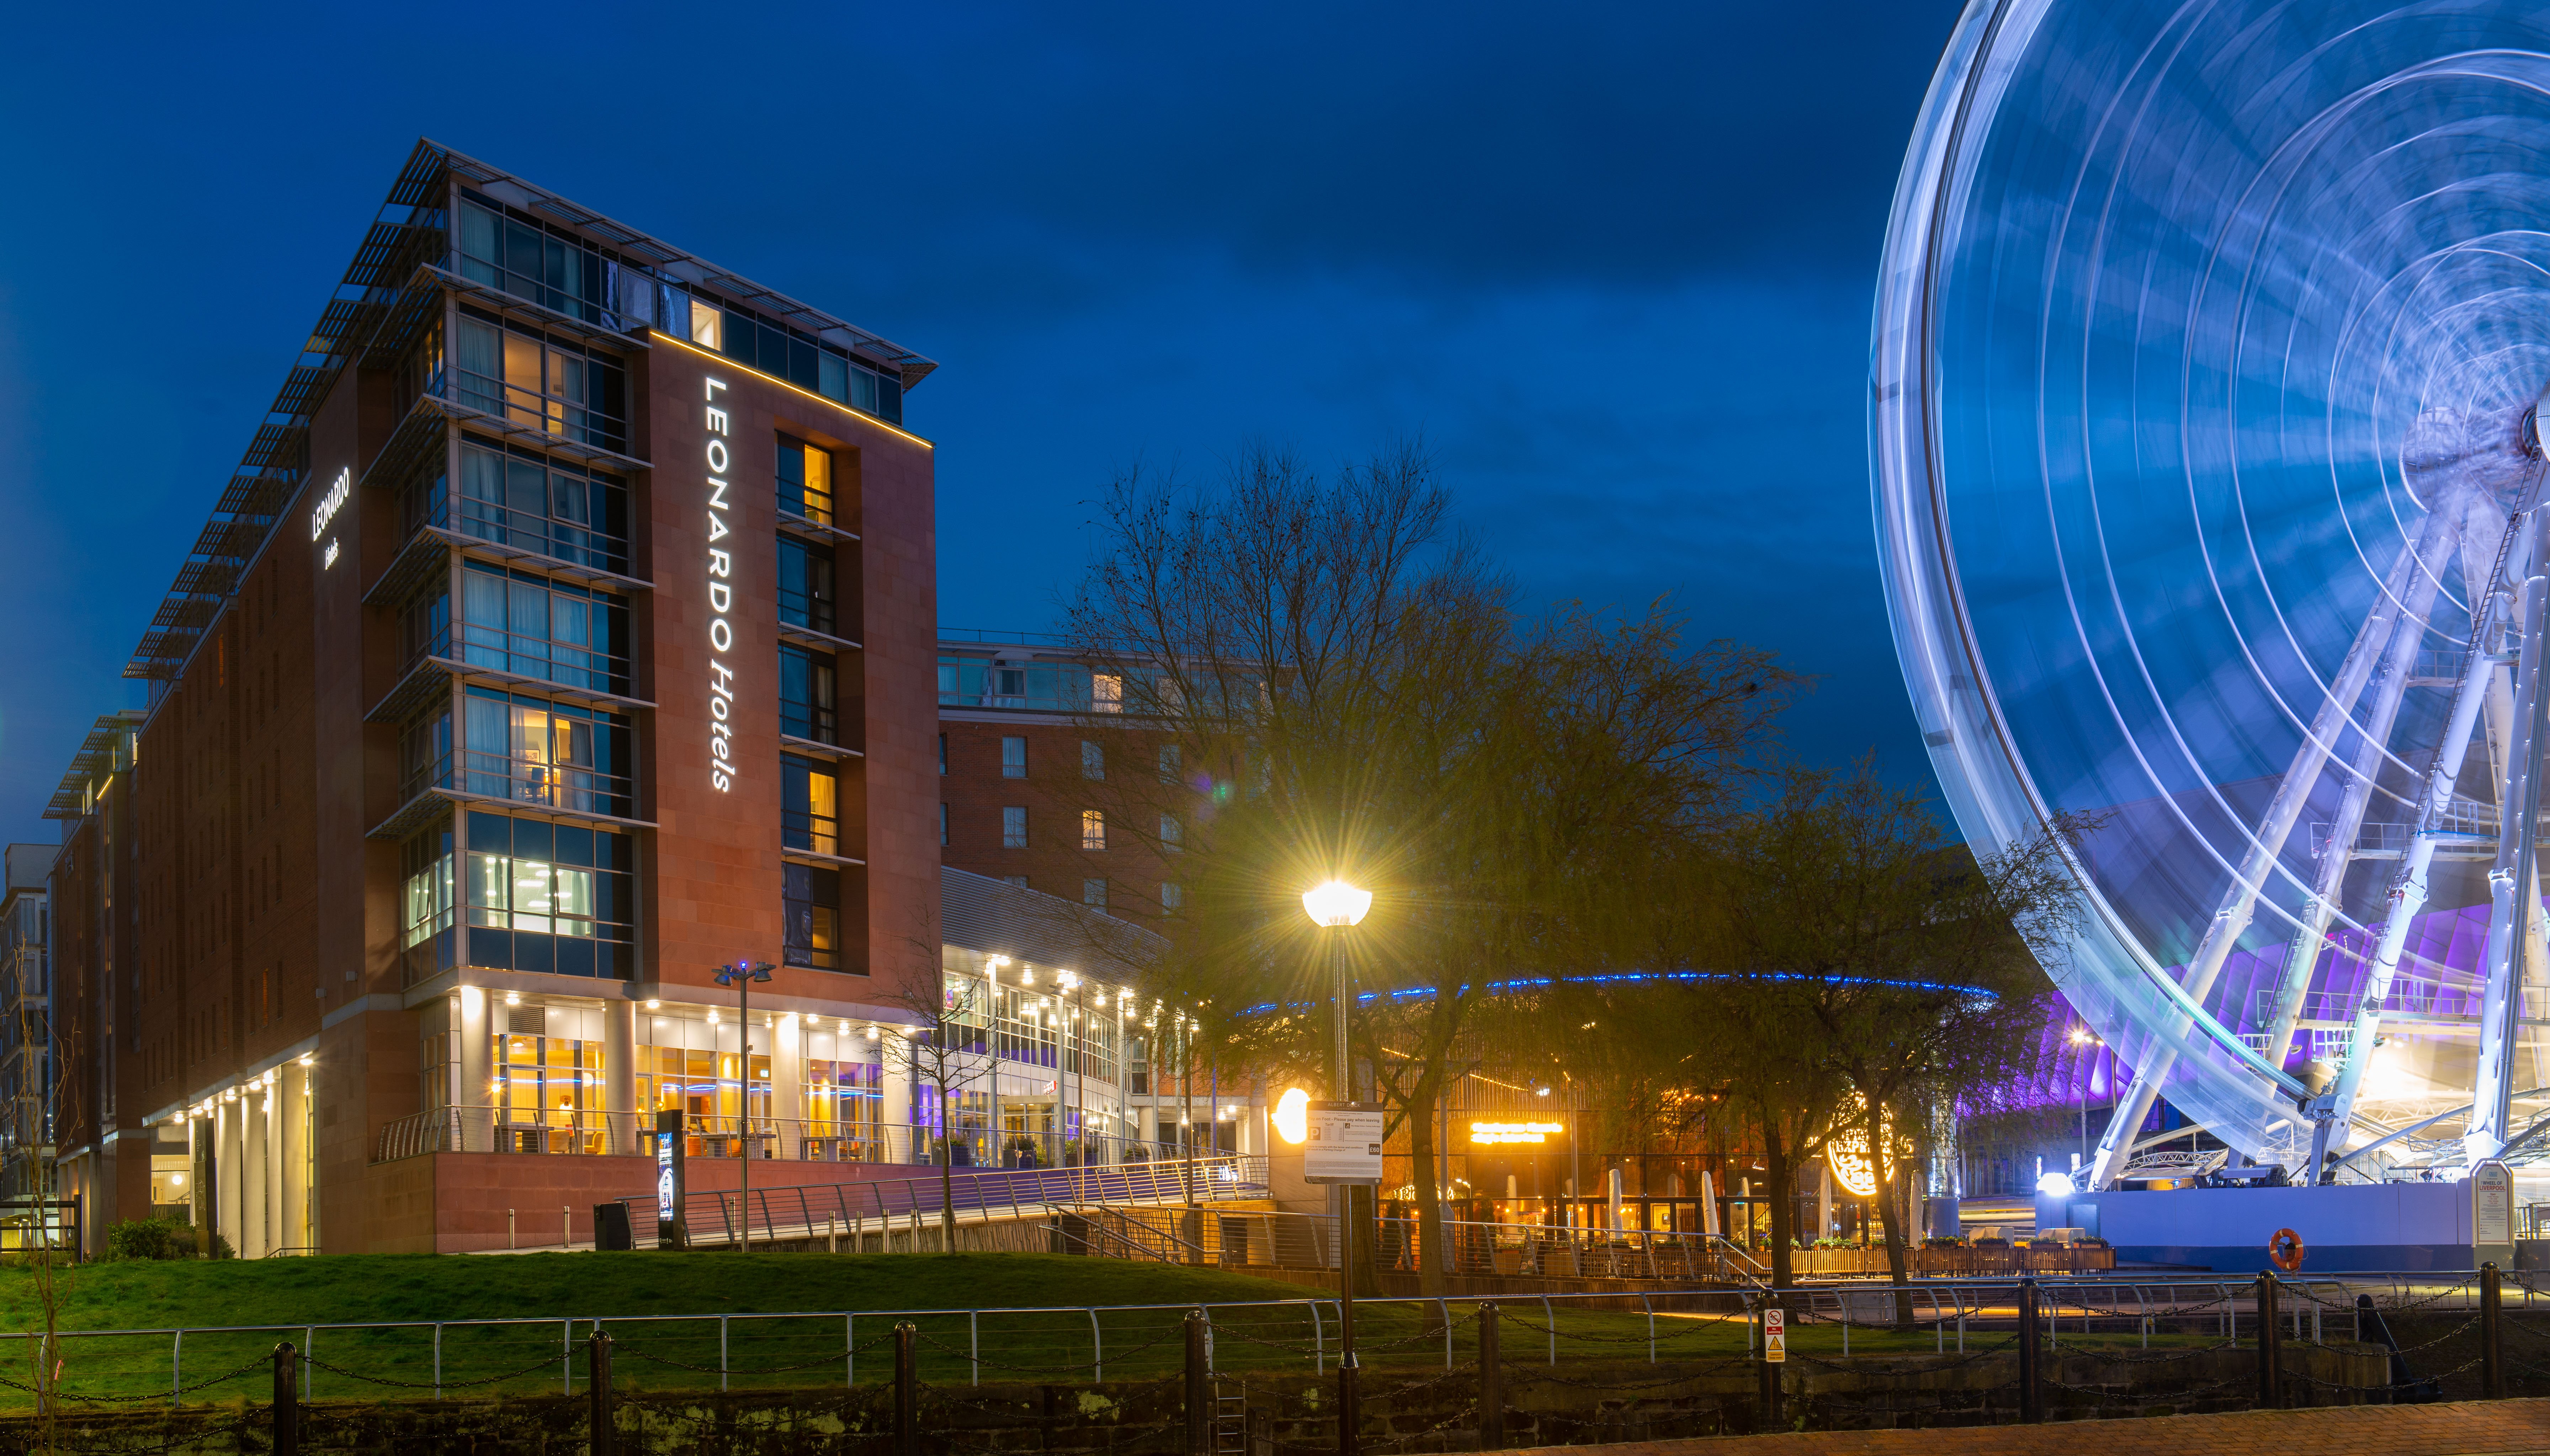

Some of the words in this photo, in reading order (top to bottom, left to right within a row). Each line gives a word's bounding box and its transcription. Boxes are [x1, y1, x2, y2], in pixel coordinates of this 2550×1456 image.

[313, 467, 349, 542] LEONARDO
[707, 378, 731, 651] LEONARDO
[712, 659, 734, 792] Hotels
